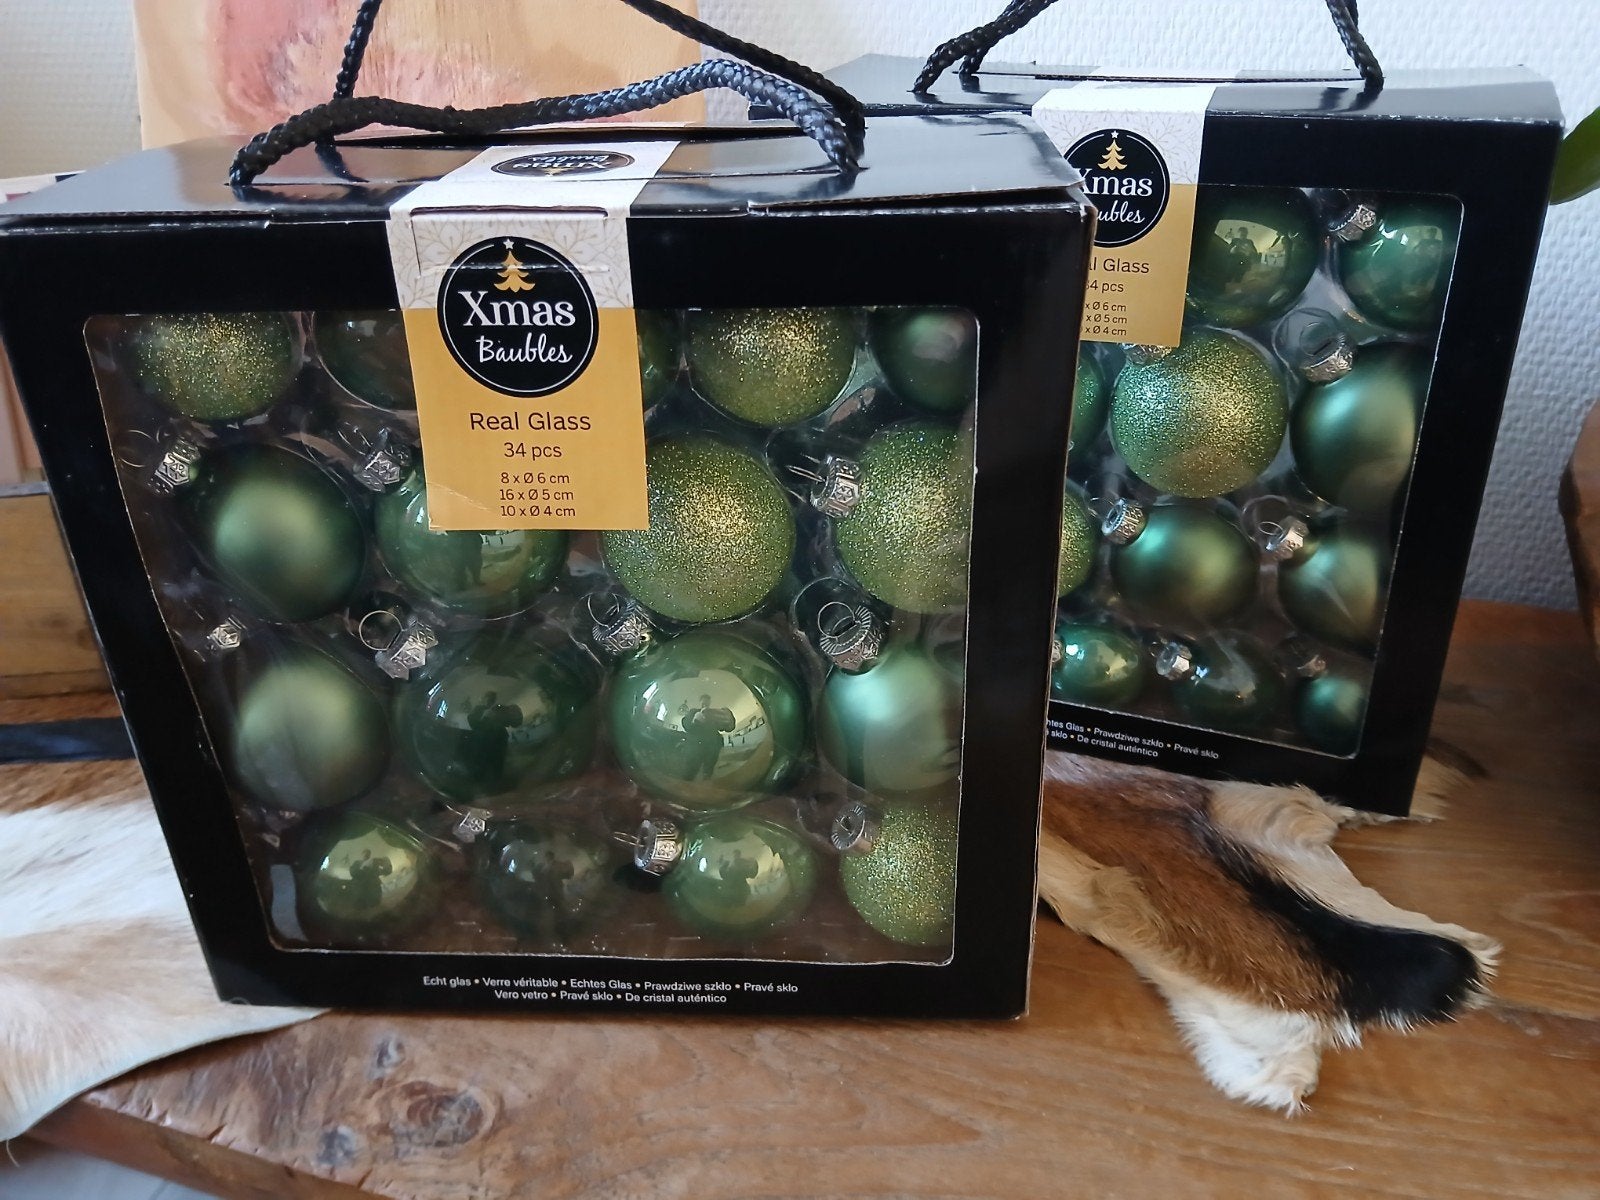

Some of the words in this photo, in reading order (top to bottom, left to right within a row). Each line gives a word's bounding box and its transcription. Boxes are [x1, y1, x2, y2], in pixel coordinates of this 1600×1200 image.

[1097, 199, 1146, 224] ubles
[1103, 257, 1150, 274] Glass
[1101, 282, 1124, 294] pcs
[457, 290, 576, 327] Xmas
[1102, 301, 1109, 311] 6
[1111, 304, 1127, 312] cm
[1103, 314, 1110, 323] 5
[1112, 316, 1128, 324] cm
[1102, 326, 1109, 335] 4
[1111, 328, 1127, 336] cm
[475, 332, 574, 364] Baubles
[469, 411, 520, 431] Real
[528, 411, 592, 431] Glass
[503, 442, 527, 458] 34
[531, 444, 563, 461] pcs
[500, 472, 509, 484] 8
[512, 474, 521, 484] x
[523, 471, 534, 484] Ø
[537, 472, 546, 484] 6
[549, 474, 570, 484] cm
[500, 488, 514, 501] 16
[517, 491, 526, 501] x
[528, 488, 539, 501] Ø
[542, 489, 551, 501] 5
[553, 491, 574, 501] cm
[501, 505, 516, 517] 10
[519, 508, 527, 517] x
[529, 504, 540, 517] Ø
[543, 505, 552, 517] 4
[555, 508, 576, 517] cm
[1065, 721, 1085, 733] Glas
[1094, 727, 1140, 744] Prawdziwe
[1077, 734, 1090, 744] De
[1091, 738, 1117, 750] cristal
[422, 975, 448, 986] Echt
[449, 975, 472, 989] glas
[482, 977, 511, 988] Verre
[513, 977, 559, 988] véritable
[570, 978, 607, 989] Echtes
[608, 979, 633, 990] Glas
[643, 981, 702, 991] Prawdziwe
[743, 982, 775, 992] Pravé
[494, 989, 519, 999] Vero
[521, 989, 549, 999] vetro
[560, 990, 590, 1001] Pravé
[625, 992, 641, 1002] De
[643, 993, 675, 1003] cristal
[677, 993, 727, 1003] auténtico
